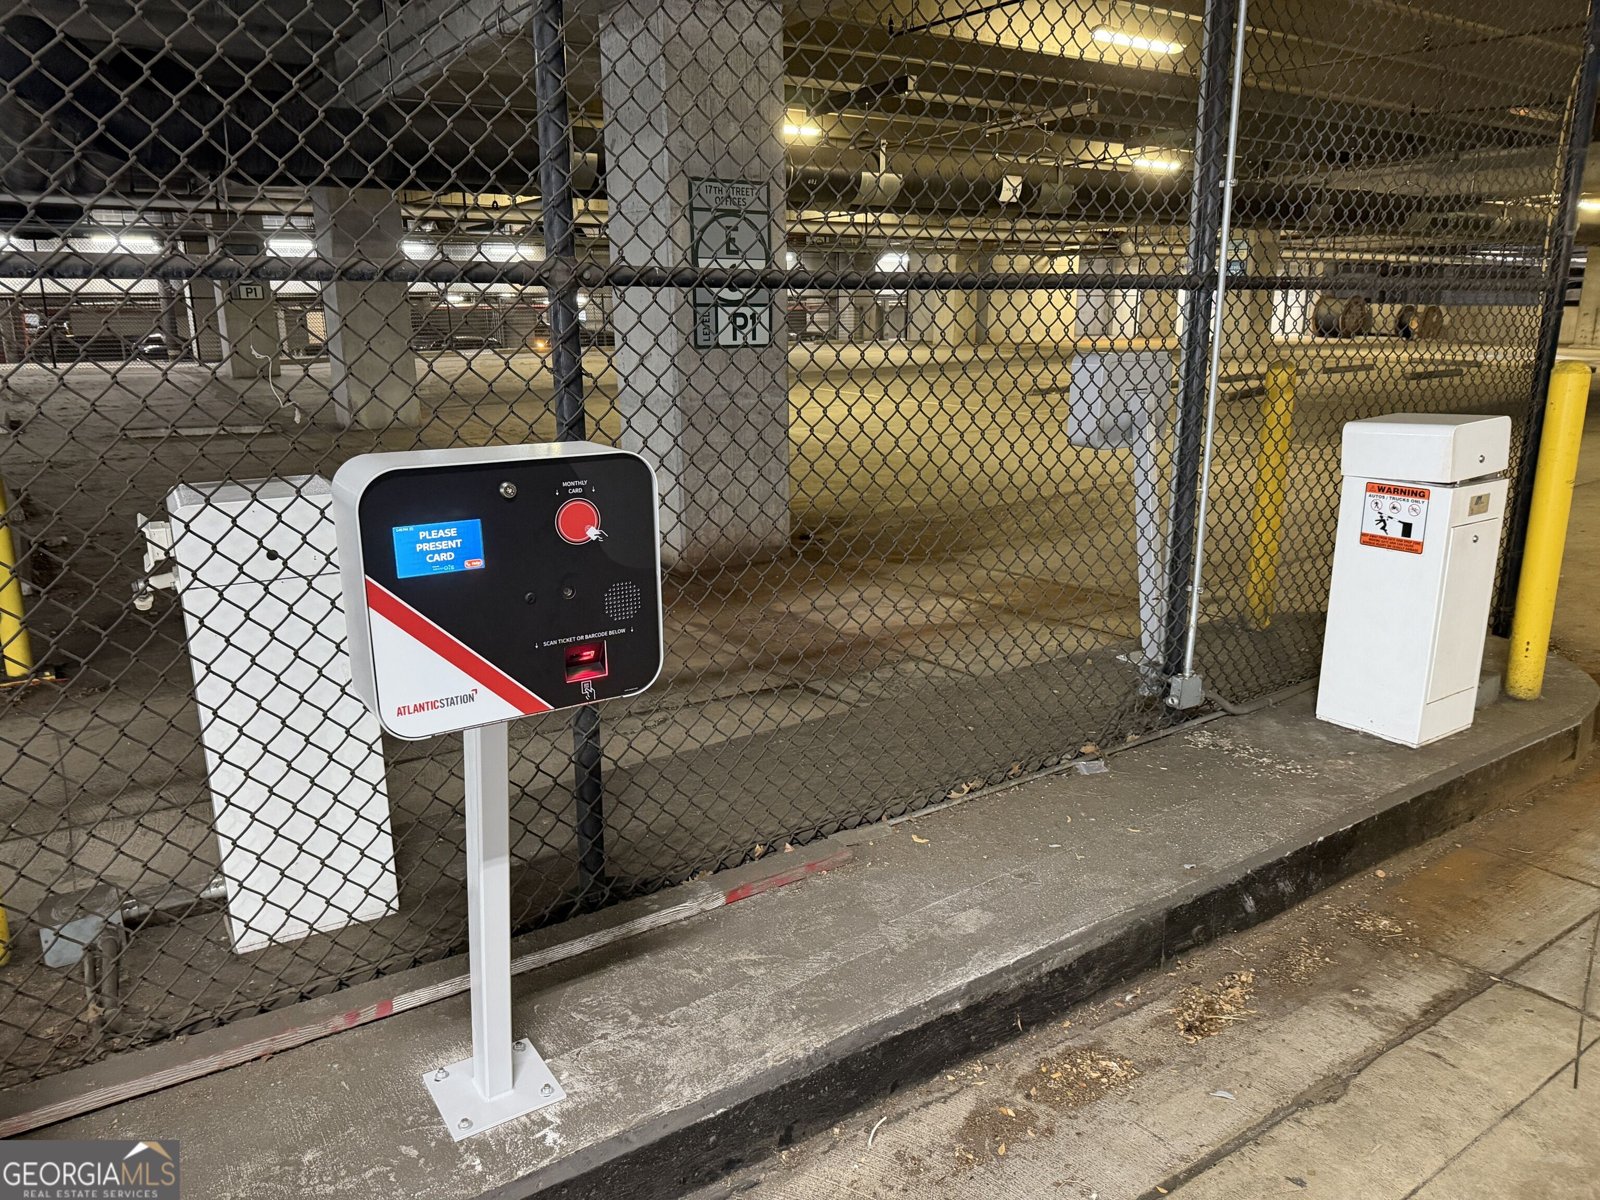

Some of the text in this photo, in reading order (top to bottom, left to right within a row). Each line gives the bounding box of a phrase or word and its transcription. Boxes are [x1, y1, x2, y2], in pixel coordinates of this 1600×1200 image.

[705, 185, 723, 195] 17TH
[725, 226, 739, 255] E
[702, 311, 711, 342] LEVEL
[732, 312, 757, 341] P1
[1377, 485, 1426, 498] WARNING
[419, 528, 458, 540] PLEASE
[416, 539, 463, 552] PRESENT
[426, 552, 455, 563] CARD
[558, 636, 576, 644] TICKET
[584, 631, 608, 640] BARCODE
[608, 628, 626, 636] BELOW
